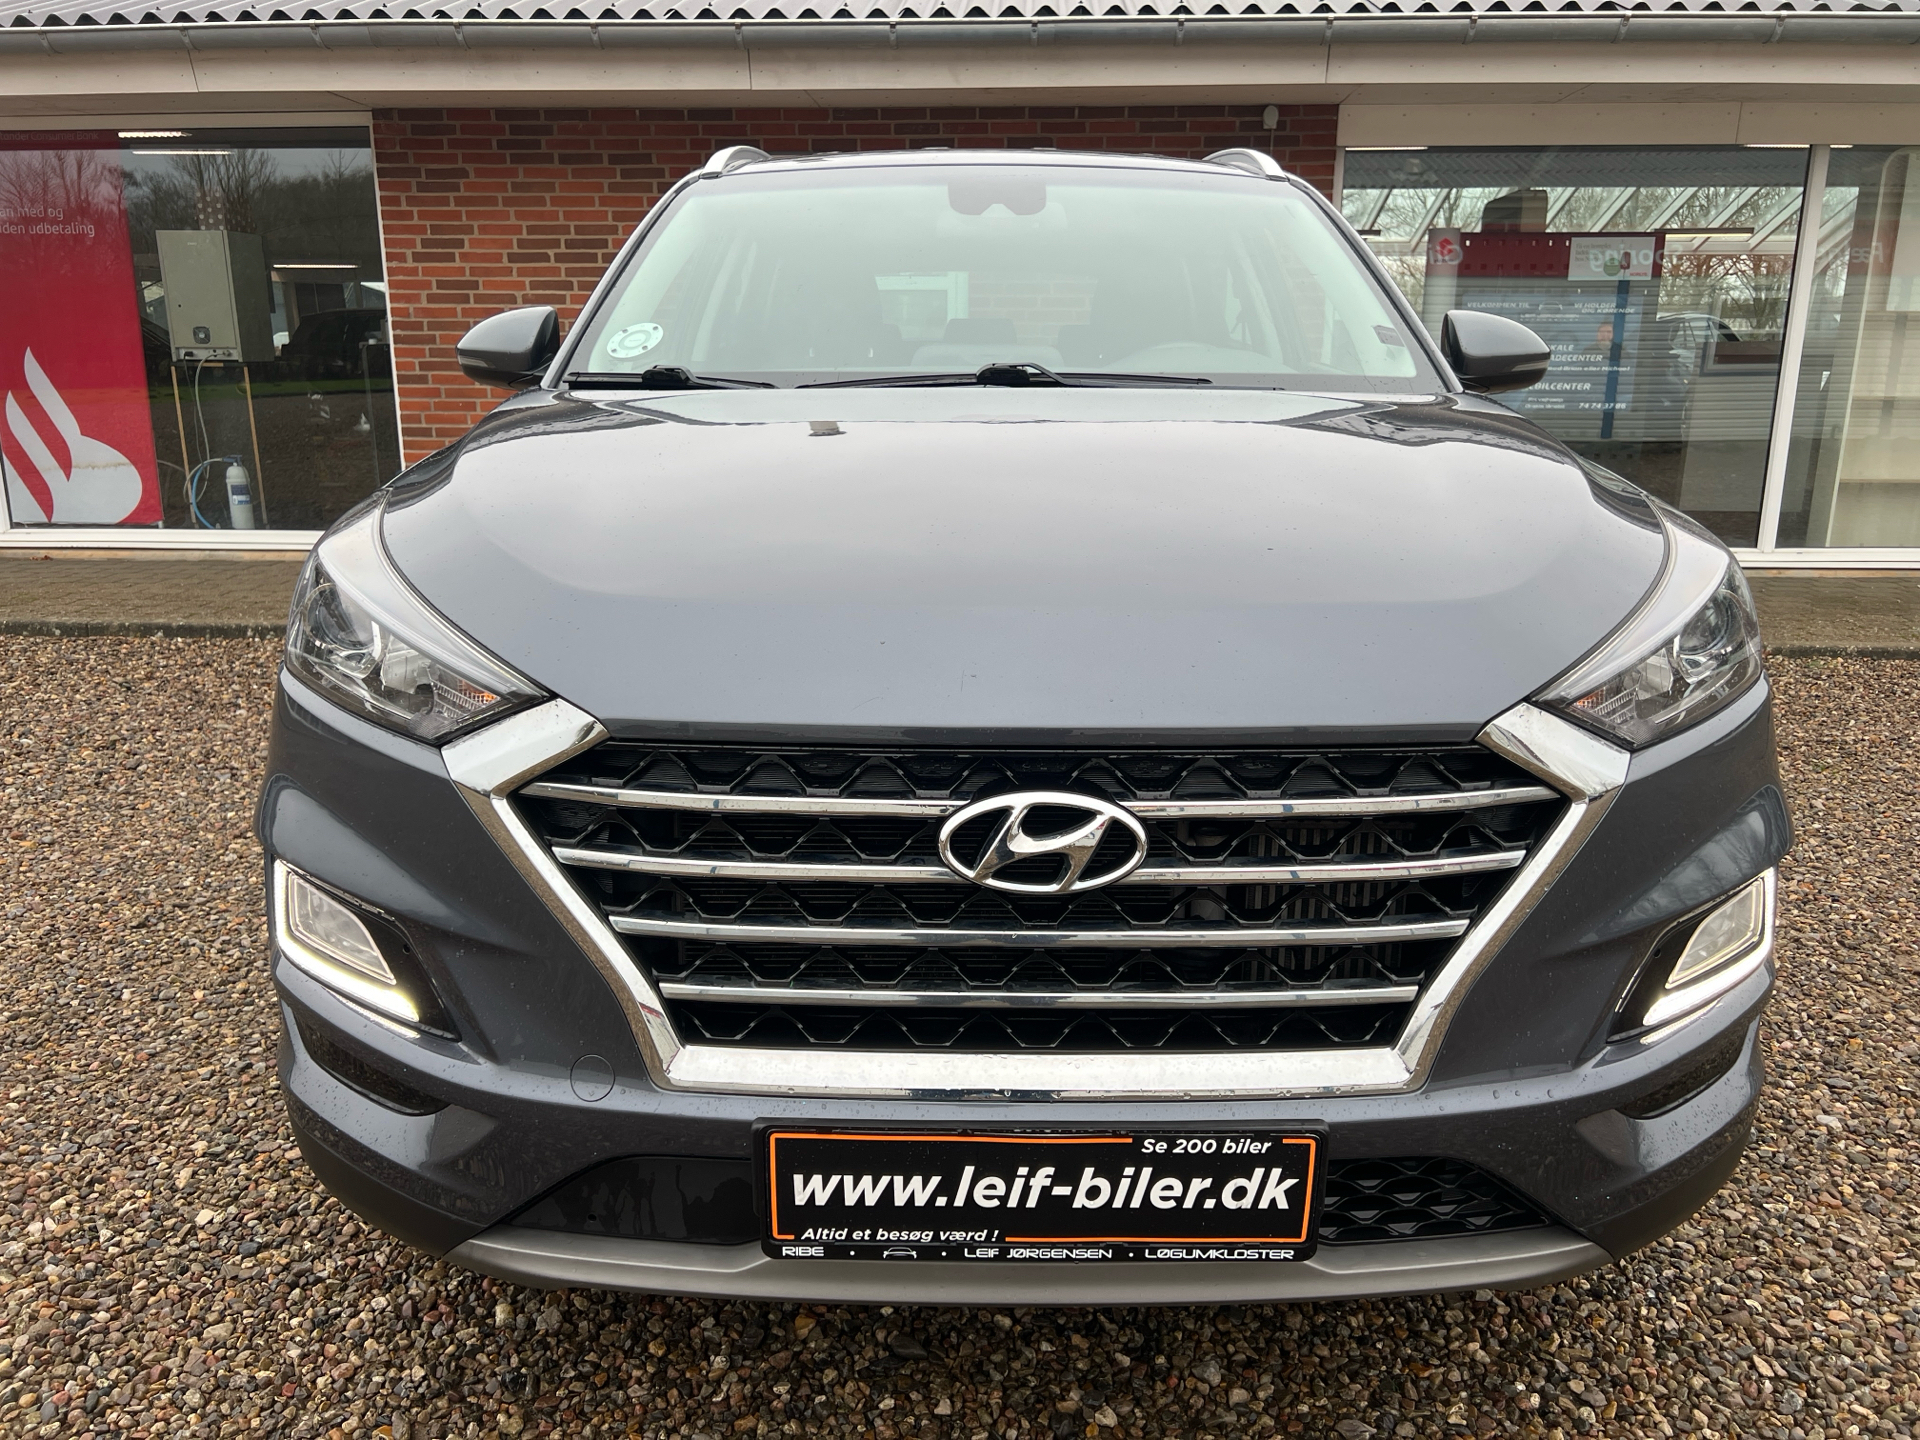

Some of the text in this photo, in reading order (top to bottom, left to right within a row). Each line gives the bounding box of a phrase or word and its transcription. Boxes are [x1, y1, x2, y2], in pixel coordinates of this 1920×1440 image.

[76, 131, 99, 140] Bank
[17, 206, 45, 218] med
[48, 208, 64, 221] og
[28, 222, 95, 238] udbetaling
[1549, 344, 1574, 352] KALE
[1550, 354, 1603, 362] ADECENTER
[1528, 383, 1591, 391] BILCENTER
[1141, 1138, 1272, 1155] Se 200 biler
[793, 1165, 1300, 1210] www.leif-biler.dk
[800, 1228, 849, 1241] Altid
[852, 1229, 872, 1241] et
[876, 1229, 934, 1243] besøg
[939, 1229, 989, 1242] værd
[782, 1246, 1295, 1260] RIBE LEIF JØRGENSEN LØGUMKLOSTER
